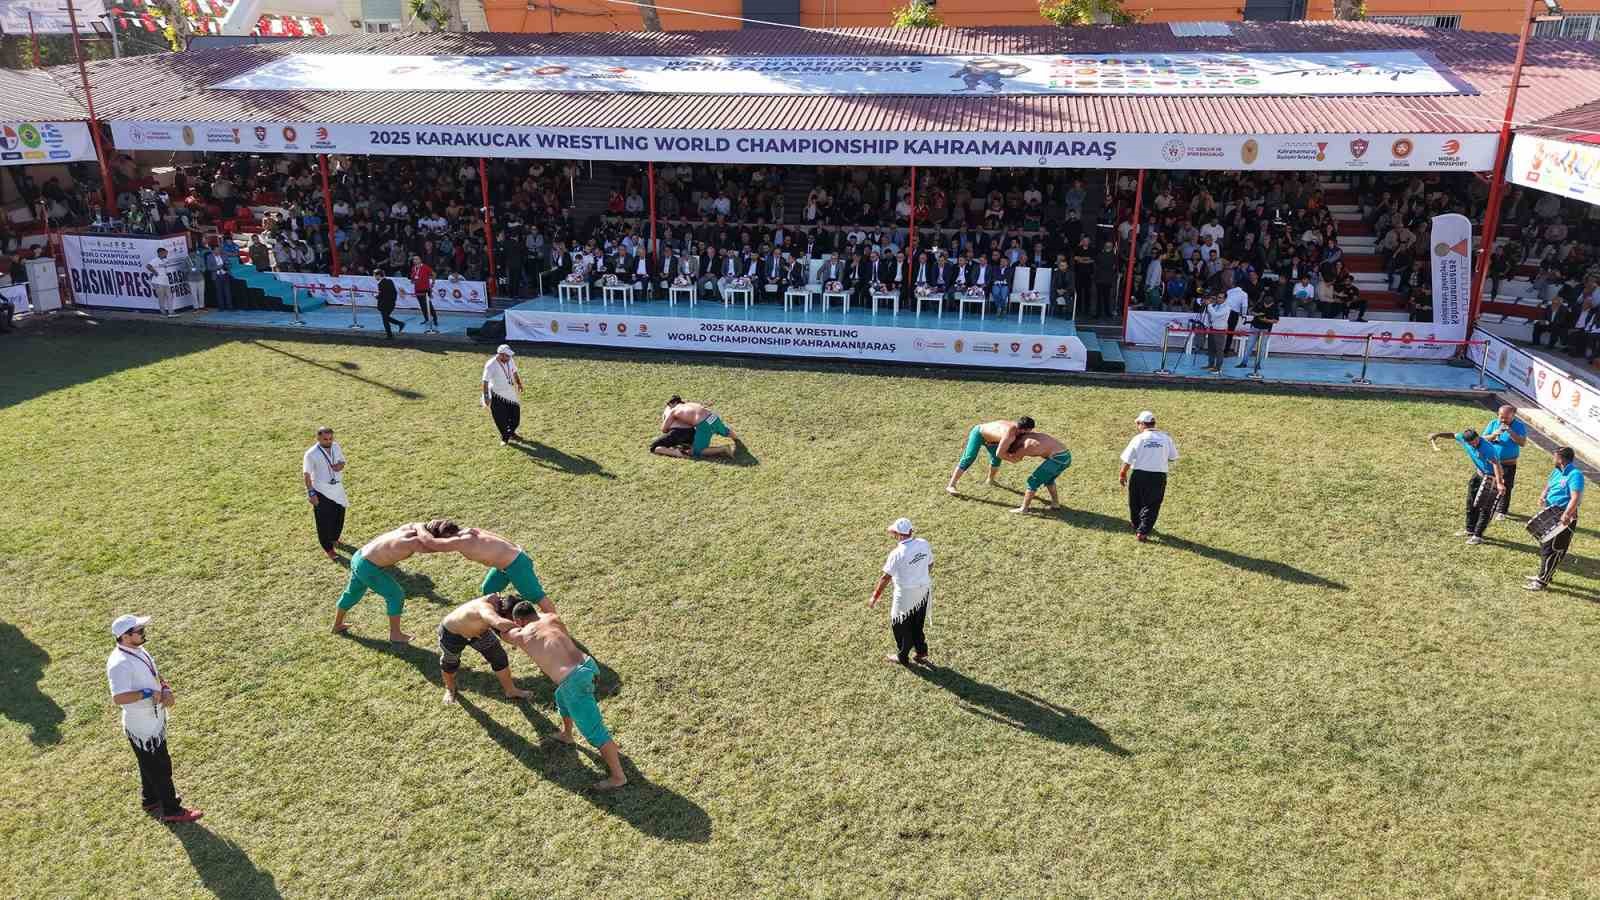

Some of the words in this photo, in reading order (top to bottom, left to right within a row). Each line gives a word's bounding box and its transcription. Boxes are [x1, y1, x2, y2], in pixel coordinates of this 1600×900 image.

[370, 130, 411, 145] 2025
[415, 131, 532, 148] KARAKUCAK
[536, 133, 649, 151] WRESTLING
[654, 136, 730, 152] WORLD
[737, 137, 899, 155] CHAMPIONSHIP
[903, 139, 1117, 162] KAHRAMANMARAŞ
[700, 323, 724, 332] 2025
[726, 324, 792, 335] KARAKUCAK
[795, 327, 858, 338] WRESTLING
[667, 332, 706, 342] WORLD
[709, 334, 791, 346] CHAMPIONSHIP
[793, 338, 897, 354] KAHRAMANMARAŞ
